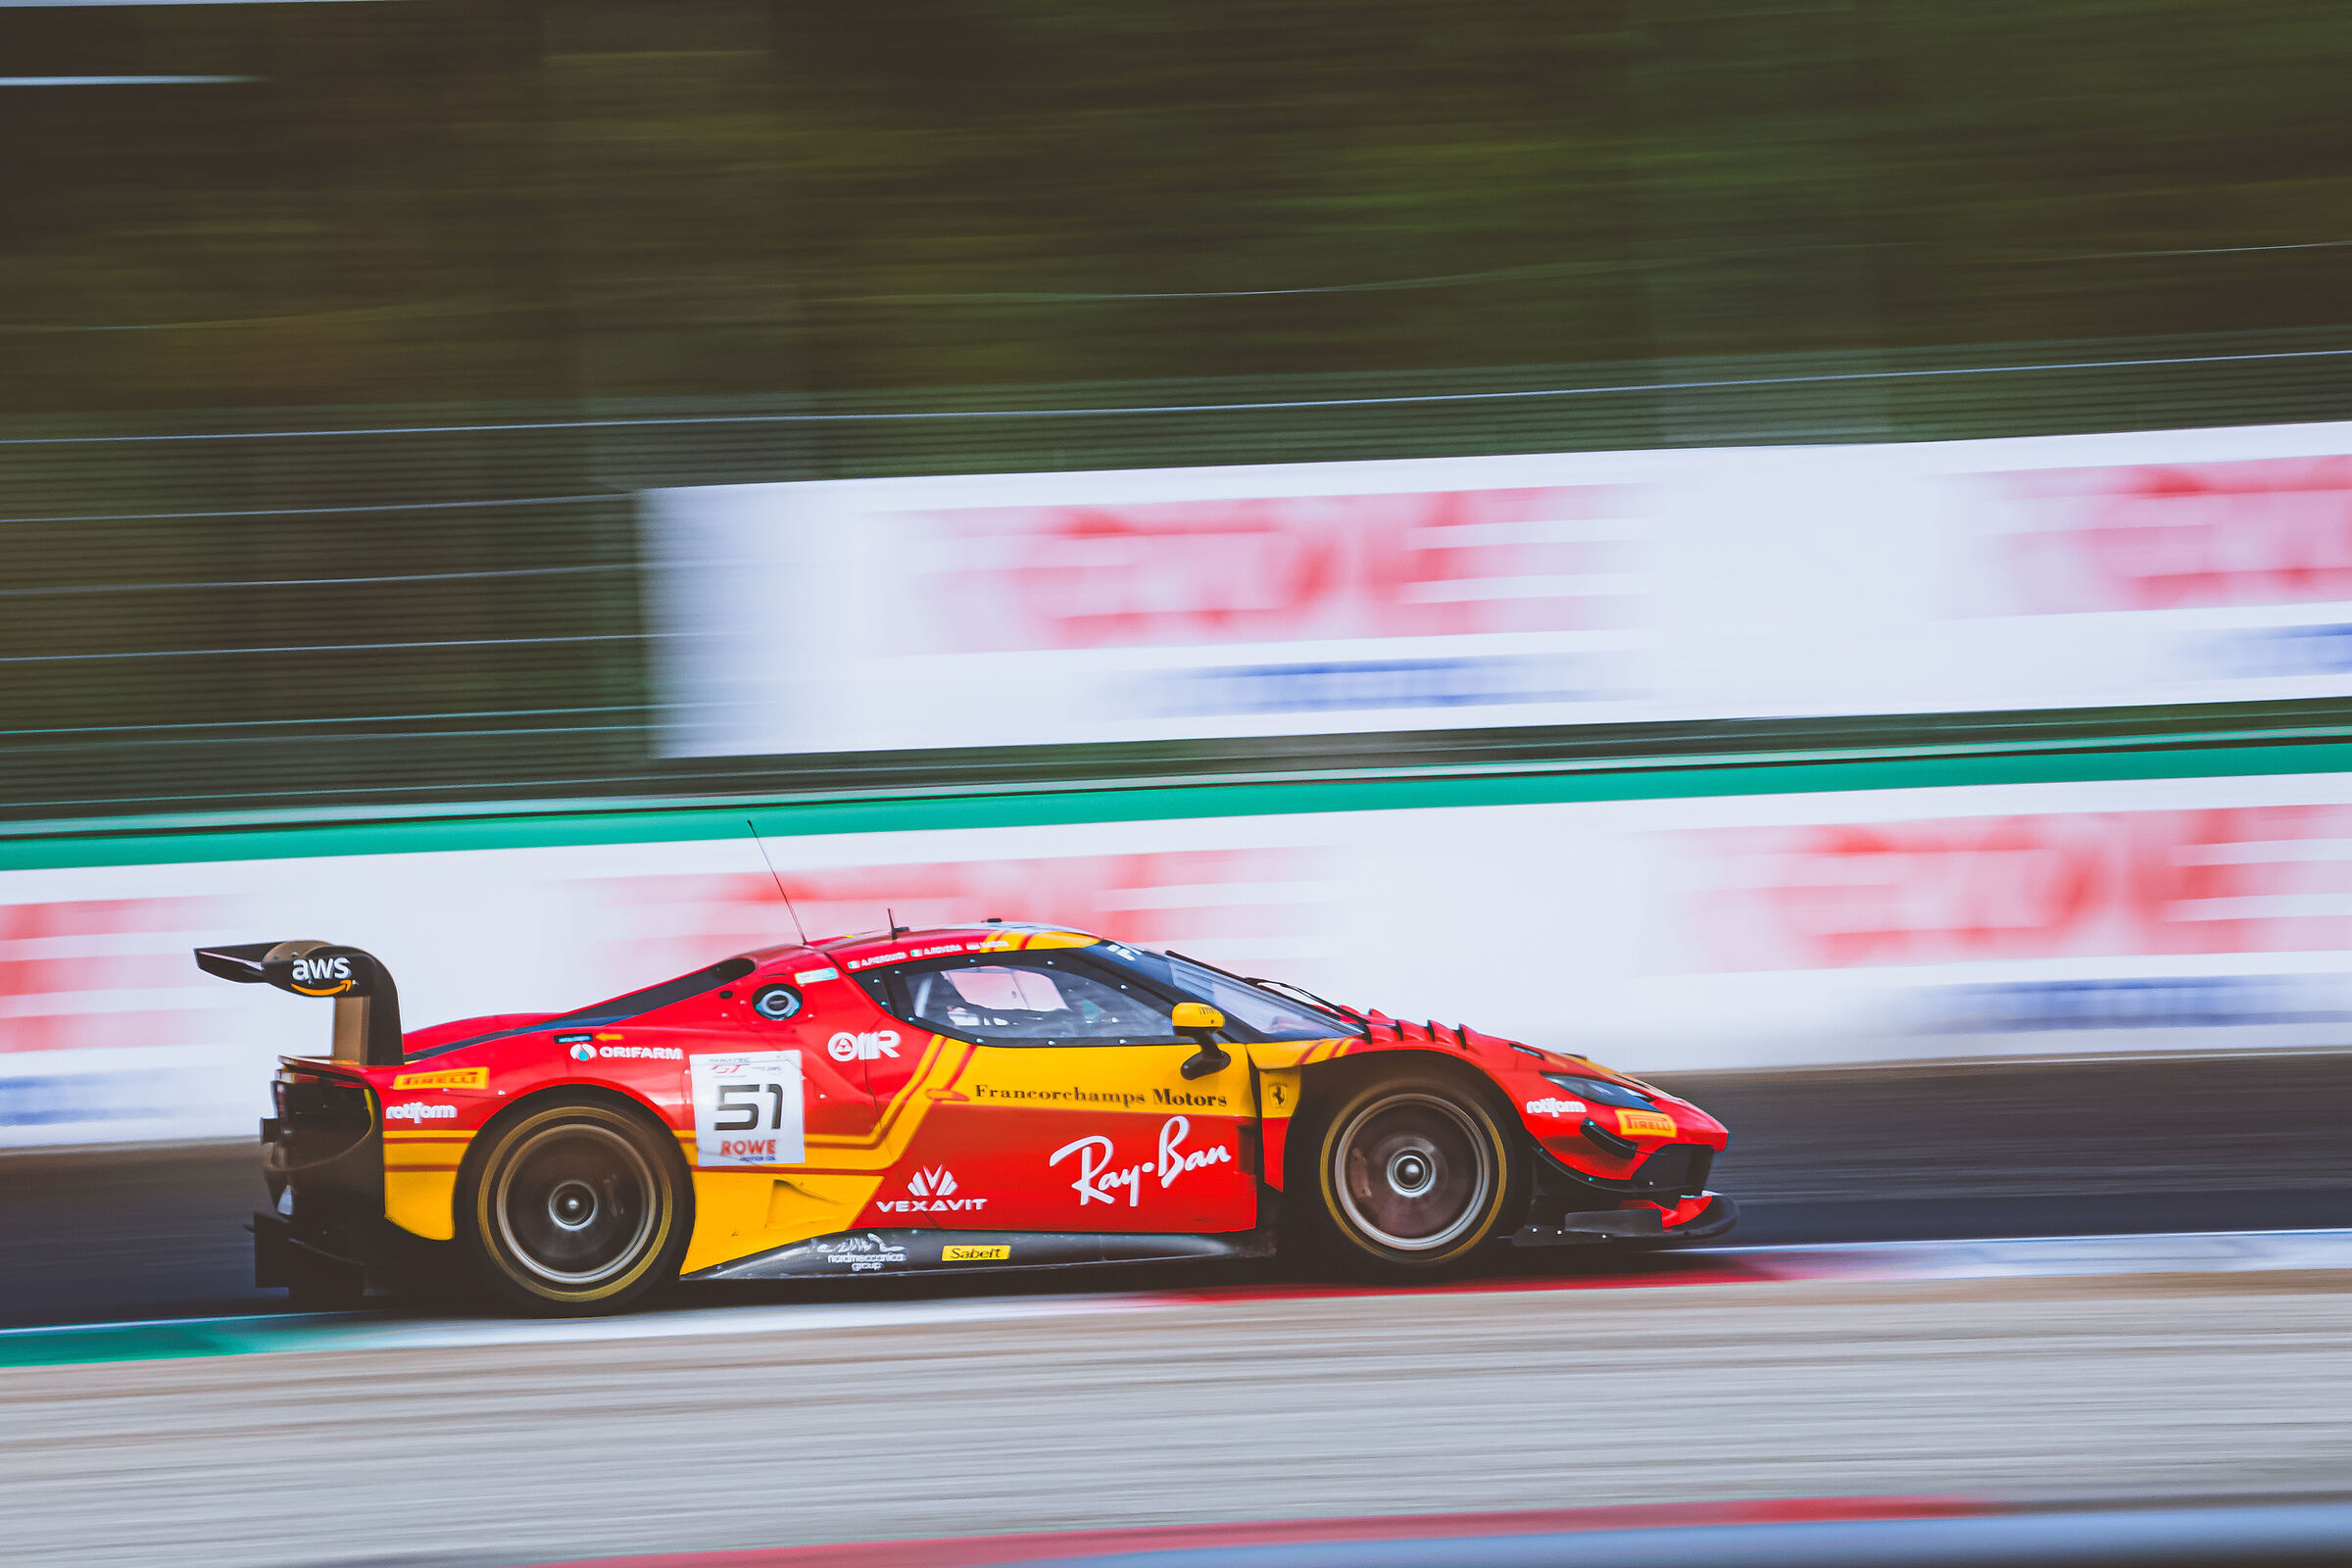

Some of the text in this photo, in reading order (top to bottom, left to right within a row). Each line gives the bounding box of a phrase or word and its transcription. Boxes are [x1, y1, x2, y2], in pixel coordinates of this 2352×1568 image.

[292, 956, 352, 981] aws
[599, 1047, 683, 1060] ORIFARM
[403, 1072, 477, 1085] PIRELLI
[975, 1084, 1228, 1107] Francorchamps Motors
[713, 1083, 783, 1131] 51
[1626, 1114, 1670, 1132] PIRELLI
[720, 1139, 776, 1156] ROWE
[876, 1199, 988, 1212] VEXAVIT
[950, 1248, 1001, 1259] Sabelt
[852, 1261, 883, 1272] group
